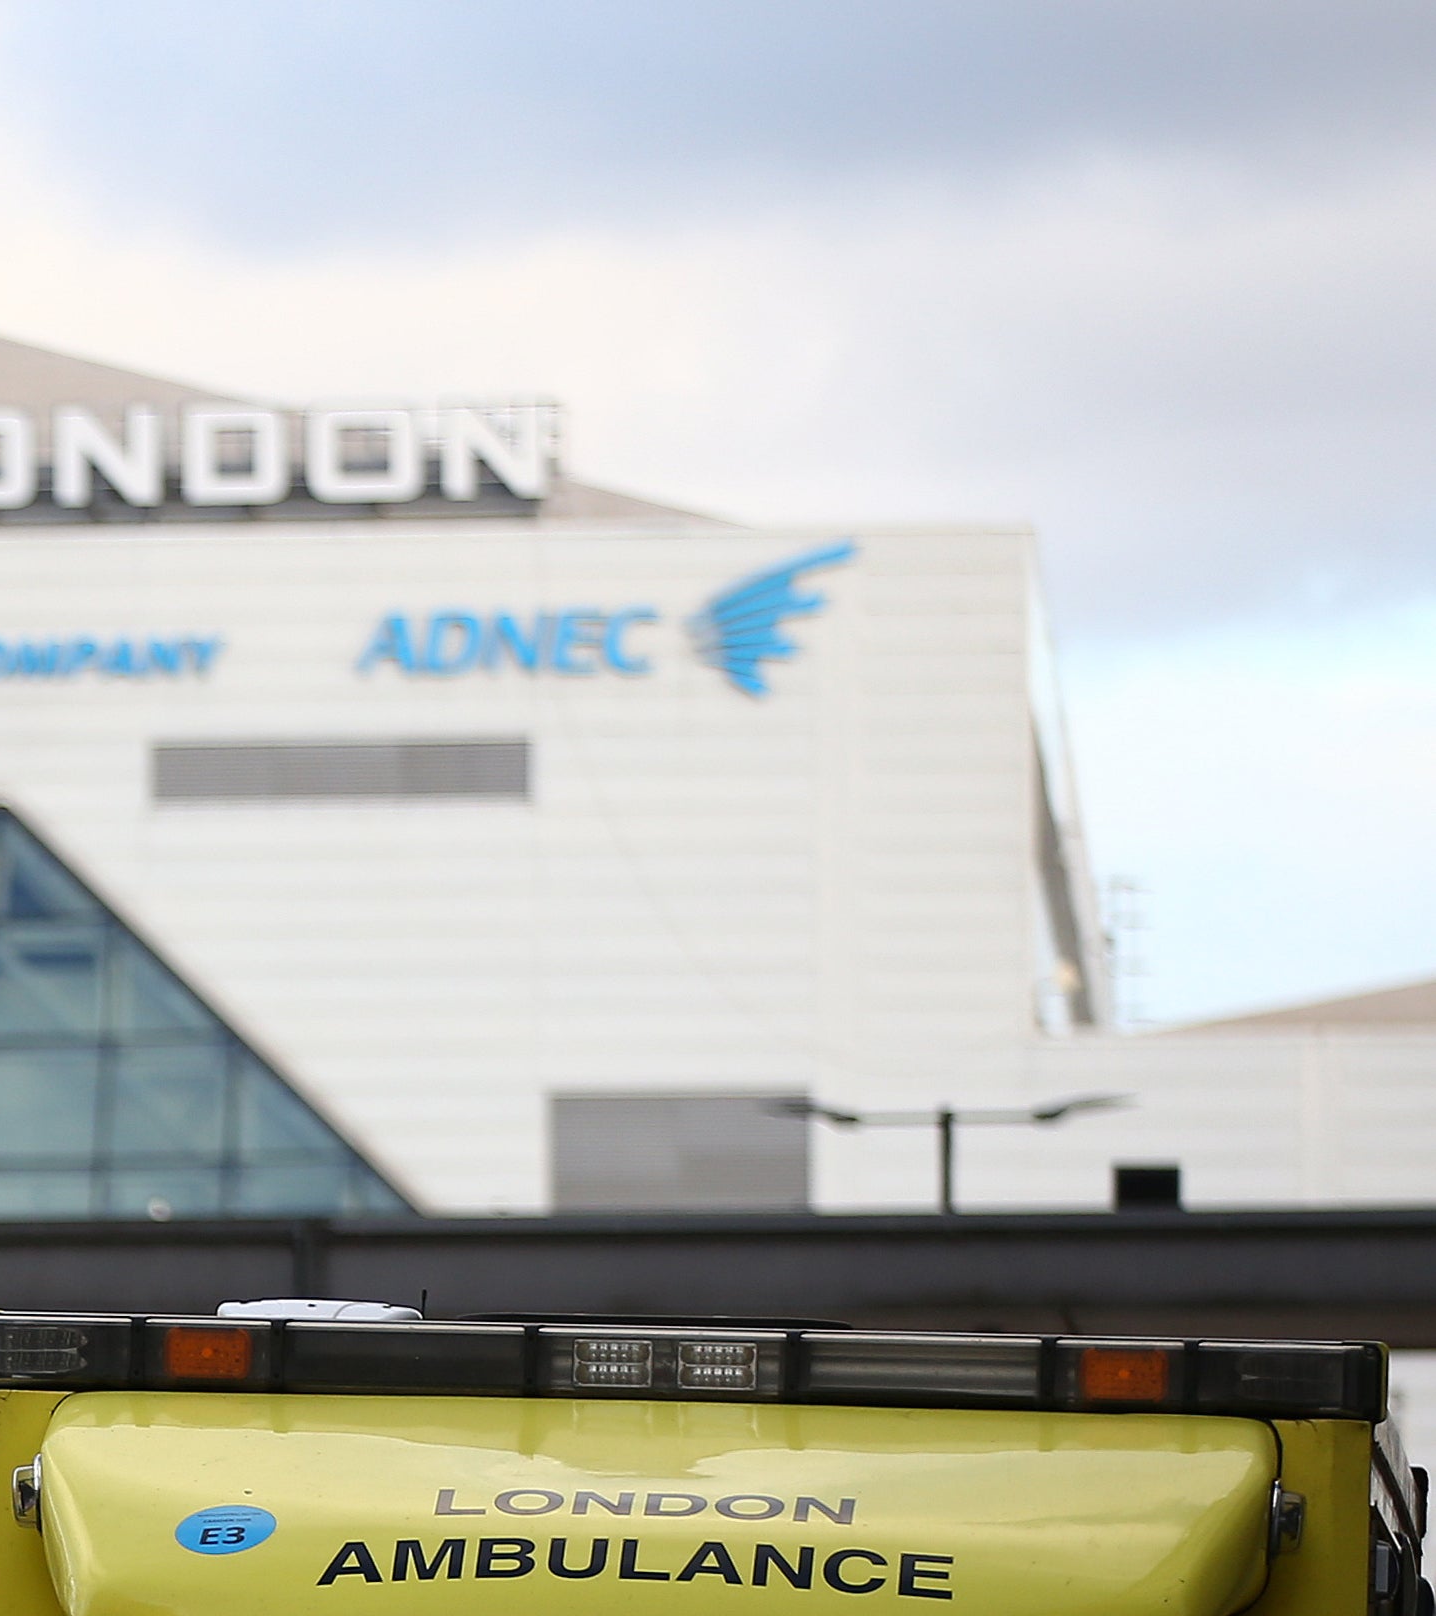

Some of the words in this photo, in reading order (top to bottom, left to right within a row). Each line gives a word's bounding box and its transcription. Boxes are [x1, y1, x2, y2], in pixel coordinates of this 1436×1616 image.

[356, 609, 656, 677] ADNEC
[433, 1488, 856, 1525] LONDON
[199, 1527, 245, 1545] E3
[317, 1536, 955, 1601] AMBULANCE
